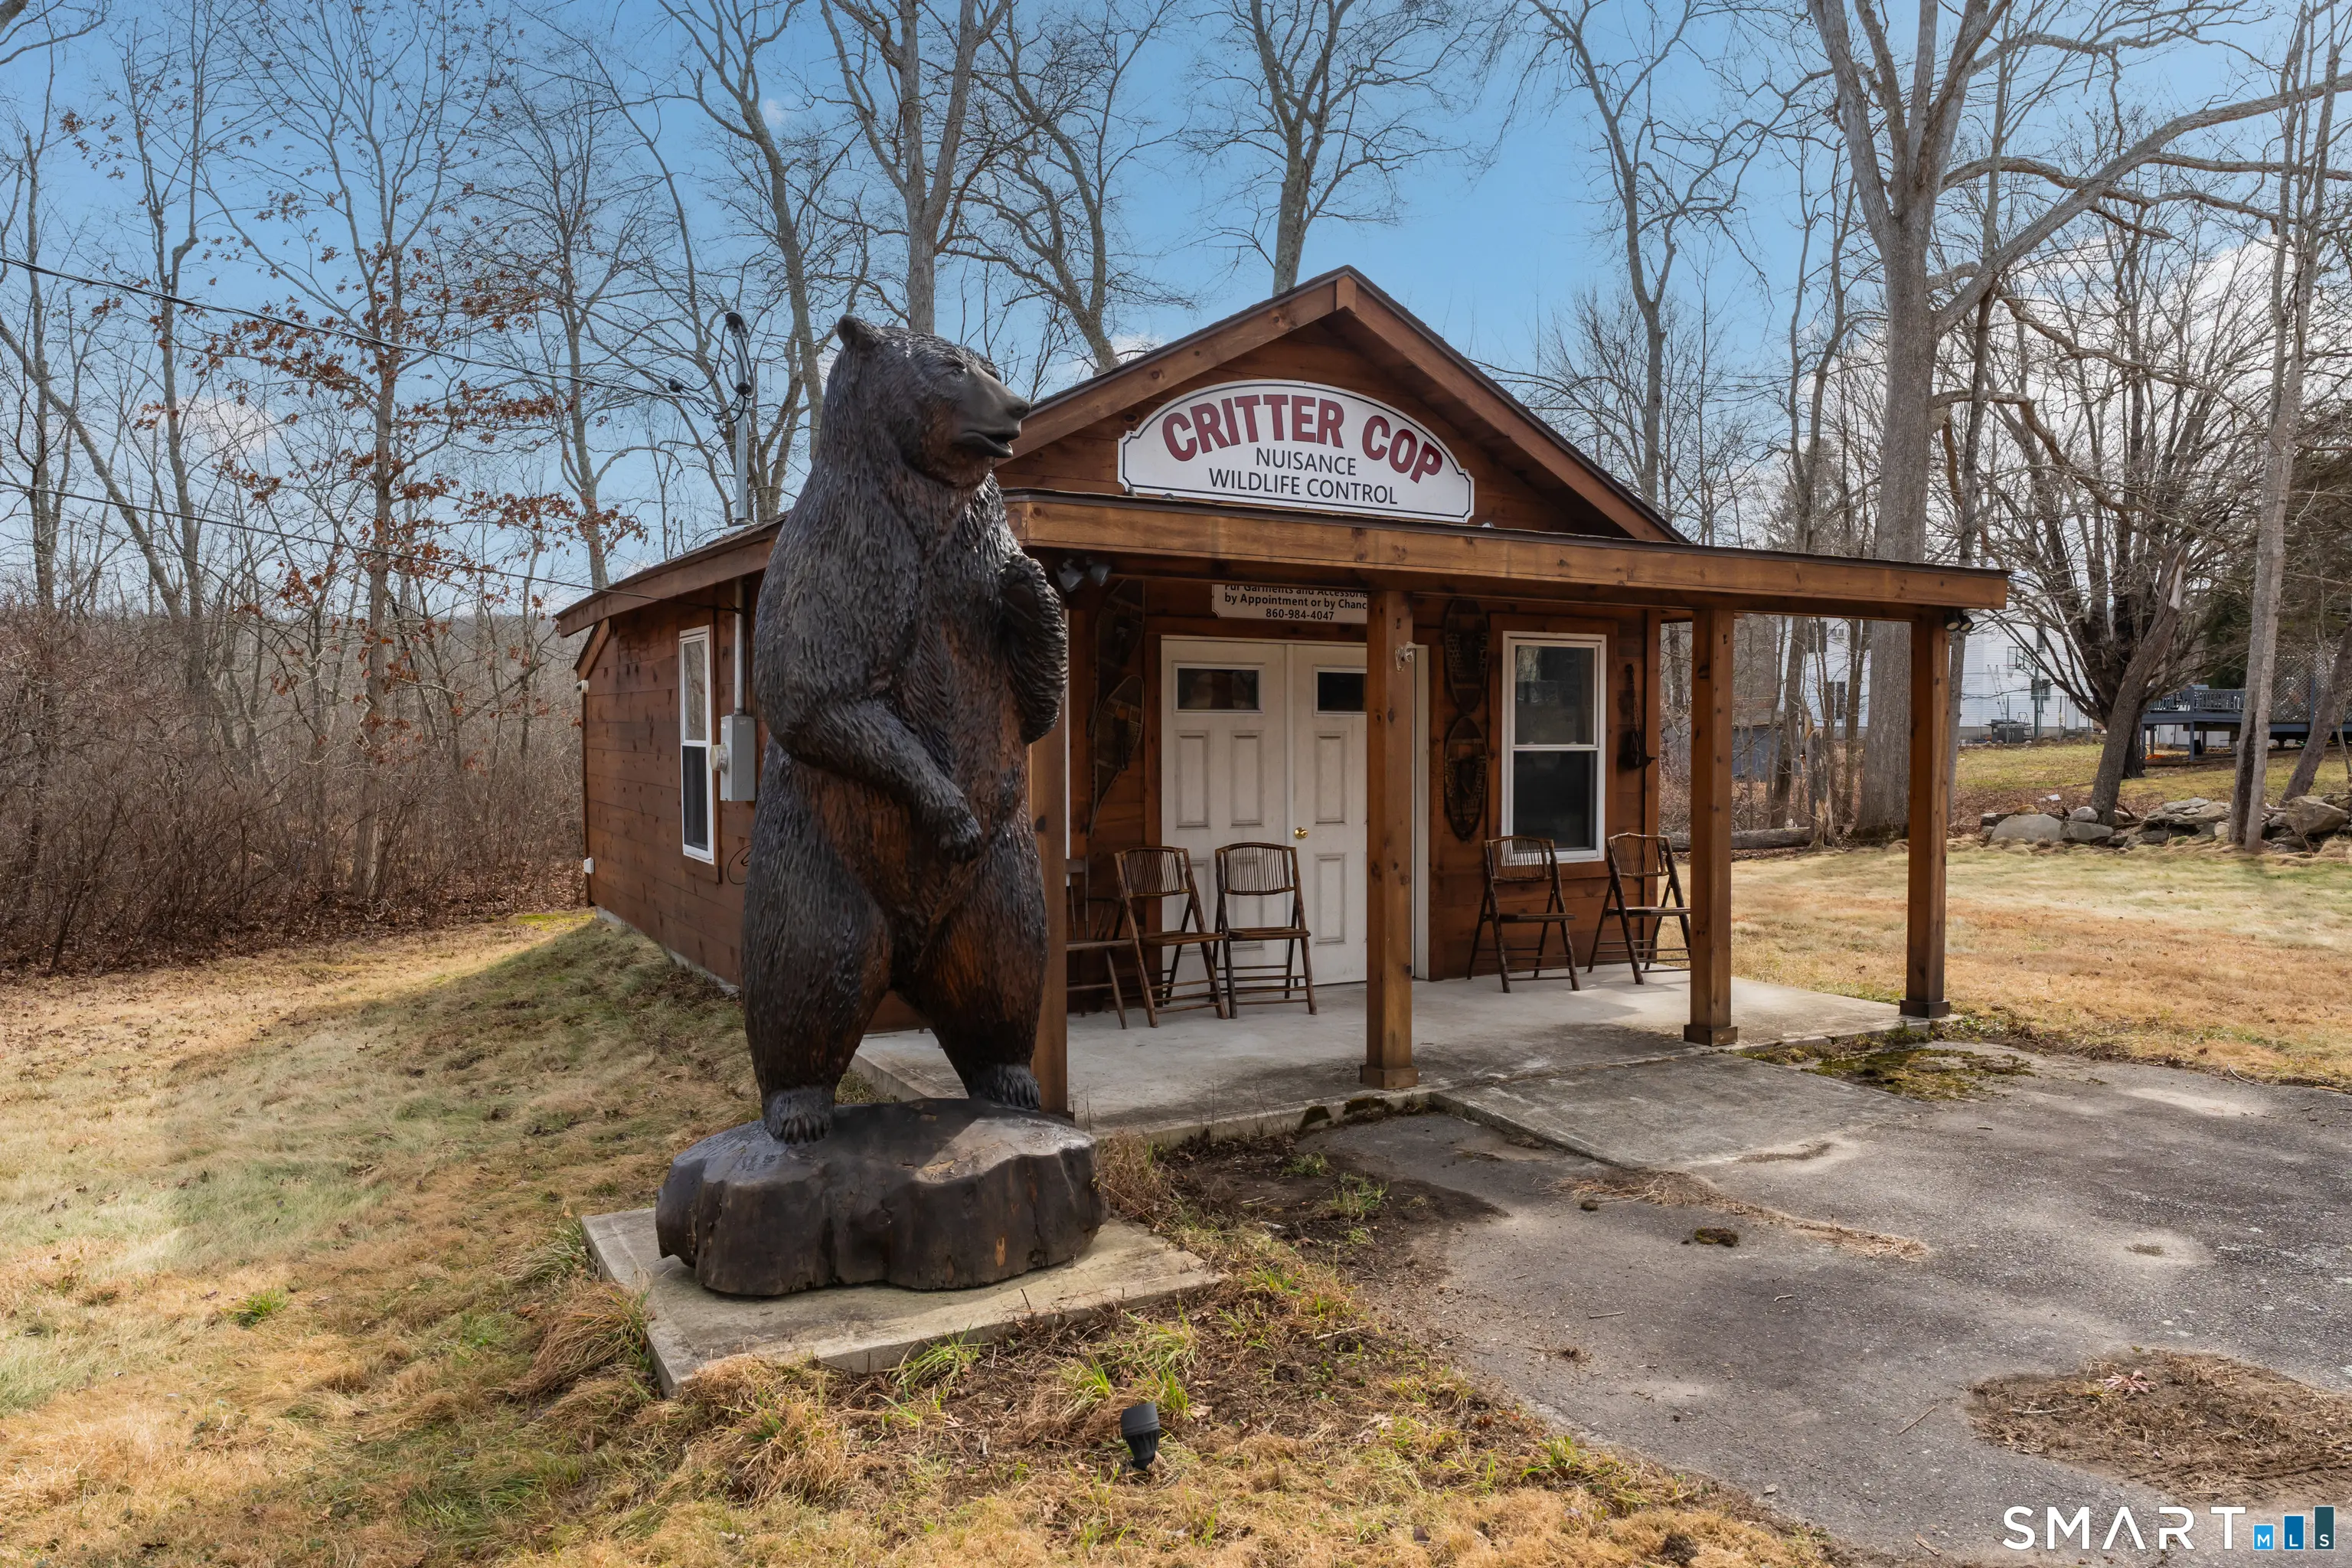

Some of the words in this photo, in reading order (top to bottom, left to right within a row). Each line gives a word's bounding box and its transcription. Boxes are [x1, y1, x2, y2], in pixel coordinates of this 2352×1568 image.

[1162, 394, 1344, 462] CRITTER
[1362, 415, 1442, 484] COP
[1256, 447, 1357, 476] NUISANCE
[1208, 467, 1301, 495] WILDLIFE
[1307, 478, 1398, 505] CONTROL
[1224, 593, 1237, 605] by
[1240, 593, 1308, 607] Appointment
[1324, 598, 1336, 610] by
[1338, 599, 1367, 609] Chanc
[1244, 585, 1294, 594] Garments
[1317, 590, 1367, 598] Accessorie
[1266, 608, 1334, 621] 860-984-4047
